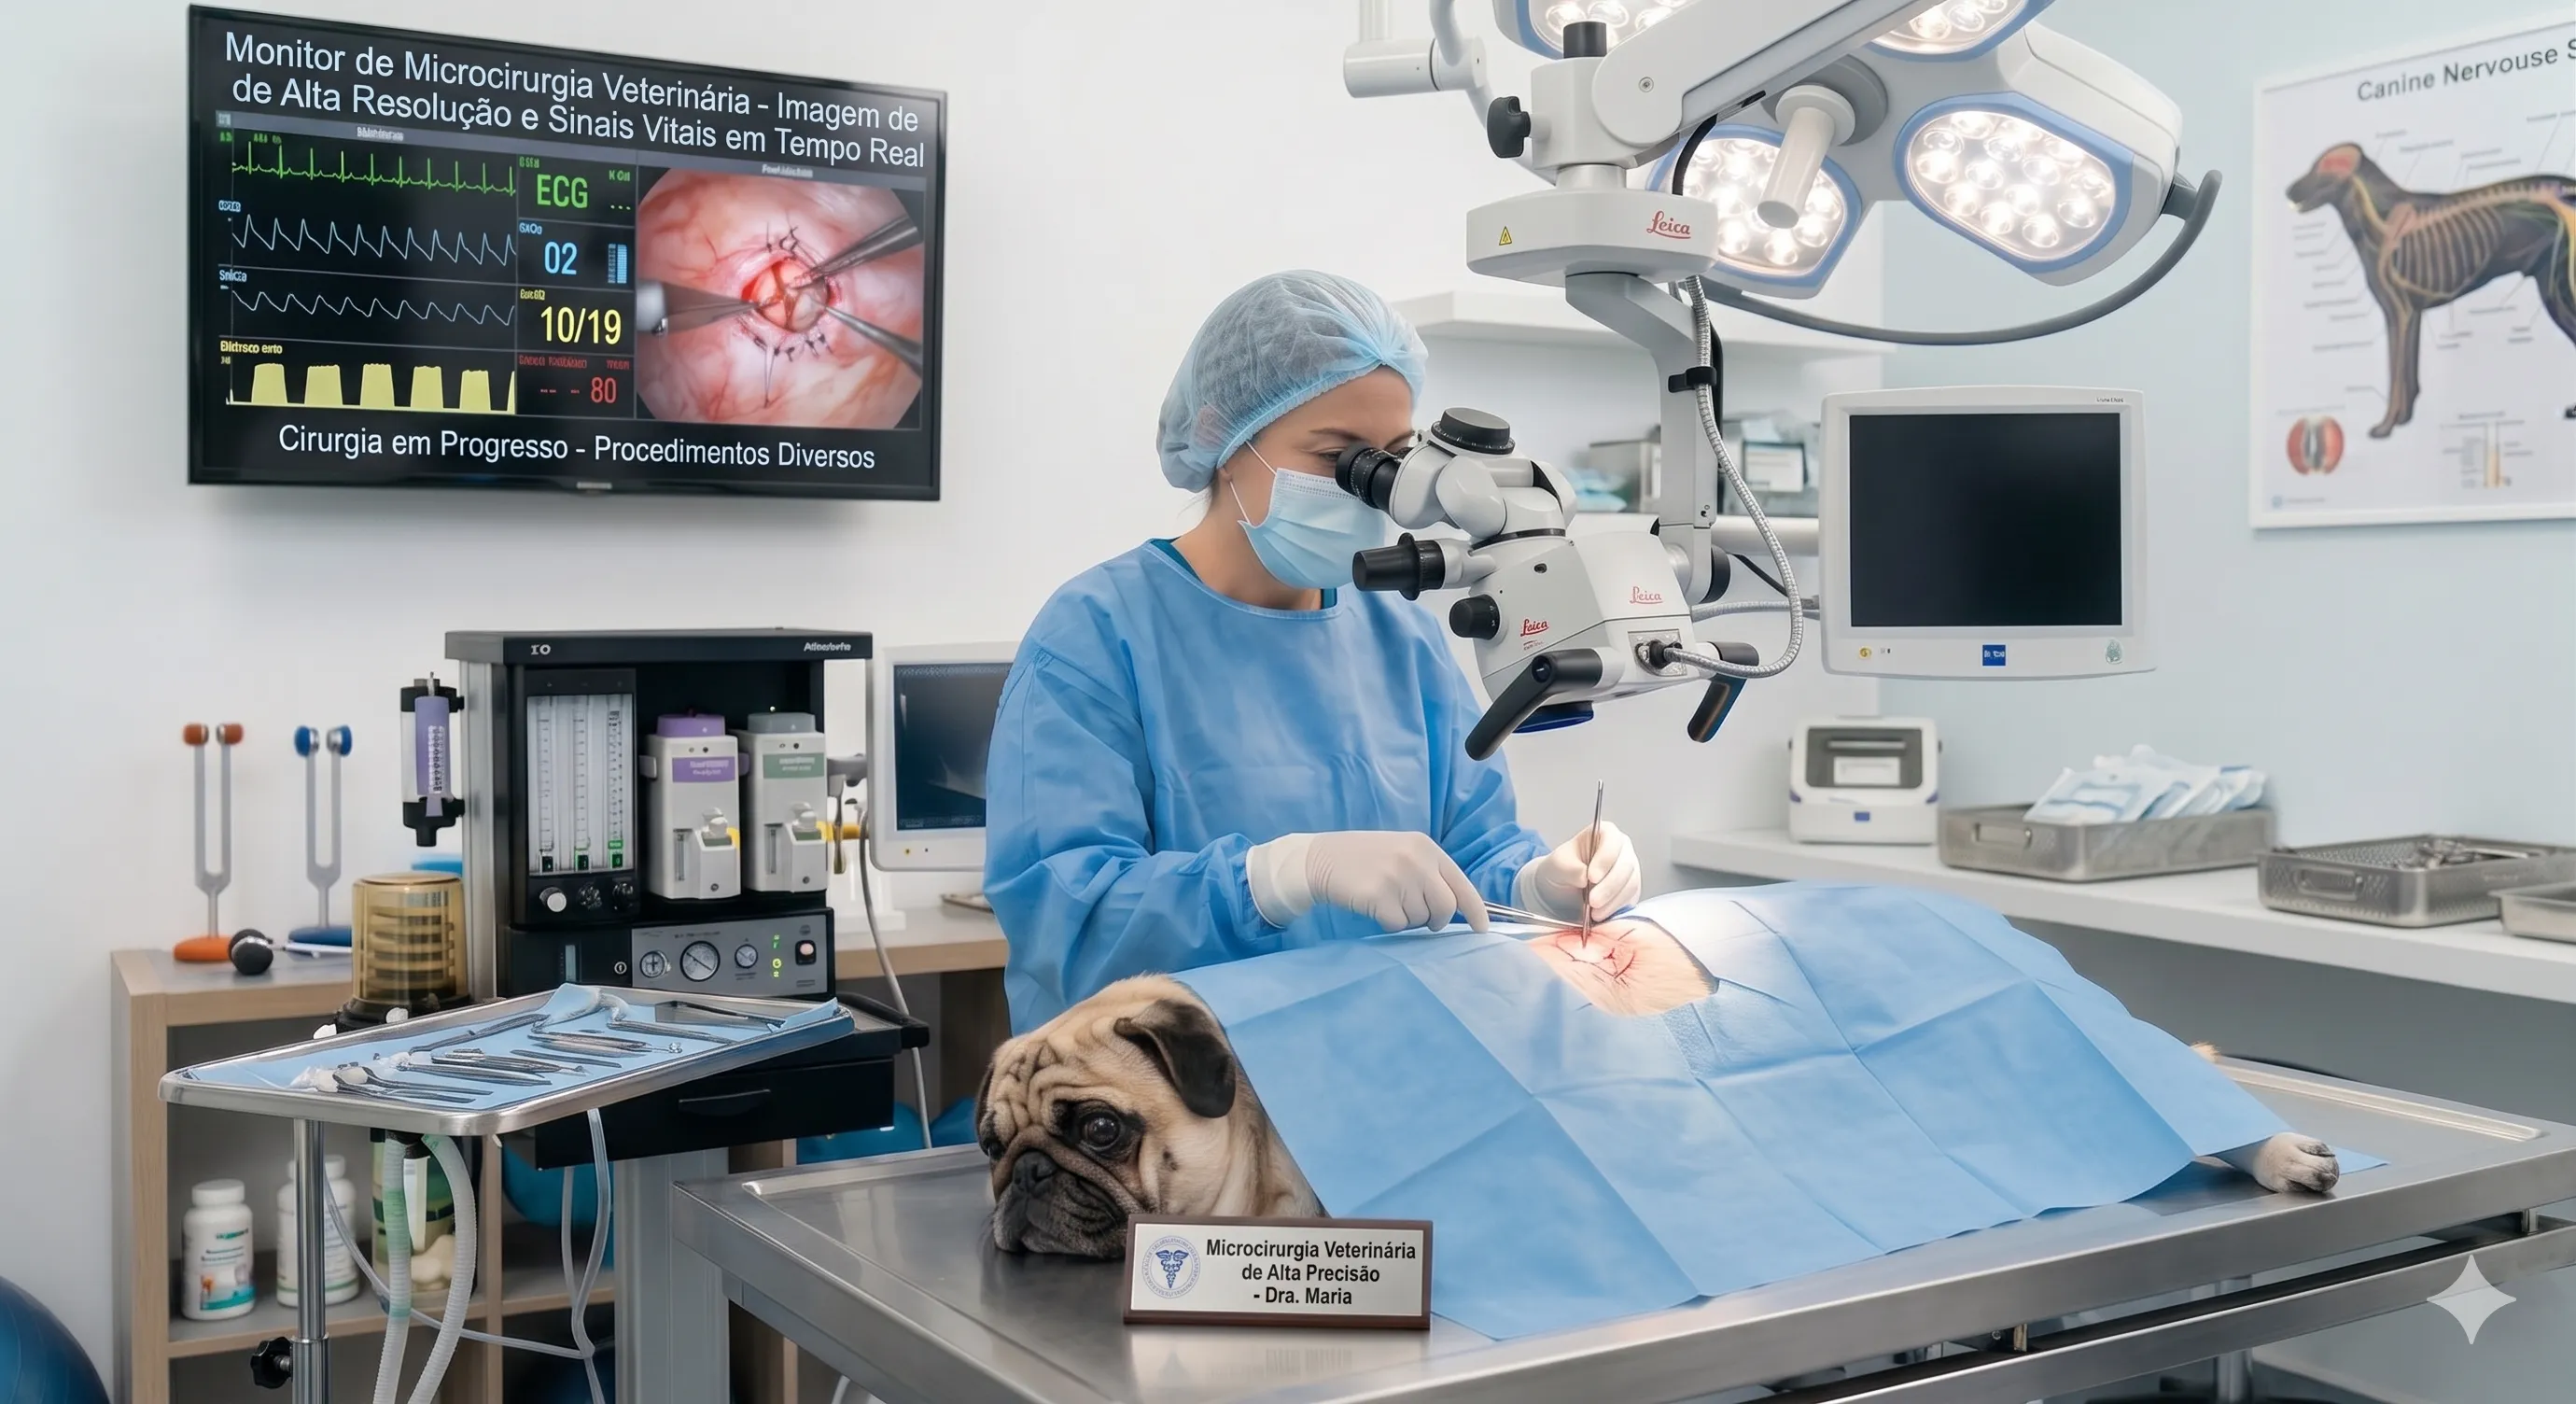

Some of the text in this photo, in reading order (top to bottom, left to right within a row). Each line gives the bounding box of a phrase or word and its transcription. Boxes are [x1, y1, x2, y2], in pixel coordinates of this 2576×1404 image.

[227, 32, 345, 71] Monitor
[357, 47, 393, 76] de
[406, 51, 593, 103] Microcirurgia
[603, 73, 749, 115] Veterinária
[779, 92, 879, 130] Imagem
[889, 106, 918, 132] de
[2358, 73, 2434, 101] Canine
[2443, 48, 2558, 85] Nervouse
[233, 74, 923, 167] de Alta Resolução e Sinais Vitais em Tempo Real
[538, 175, 587, 208] ECG
[1646, 210, 1691, 240] Leica
[545, 242, 577, 274] 02
[541, 306, 621, 344] 10/19
[591, 377, 616, 403] 80
[280, 425, 382, 457] Cirurgia
[393, 435, 430, 455] em
[441, 430, 567, 462] Progresso
[595, 436, 769, 465] Procedimentos
[779, 442, 875, 468] Diversos
[1207, 1240, 1415, 1261] Microcirurgia Veterinária
[1242, 1264, 1379, 1282] de Alta Precisão
[1266, 1286, 1299, 1303] Dra.
[1306, 1287, 1351, 1304] Maria
